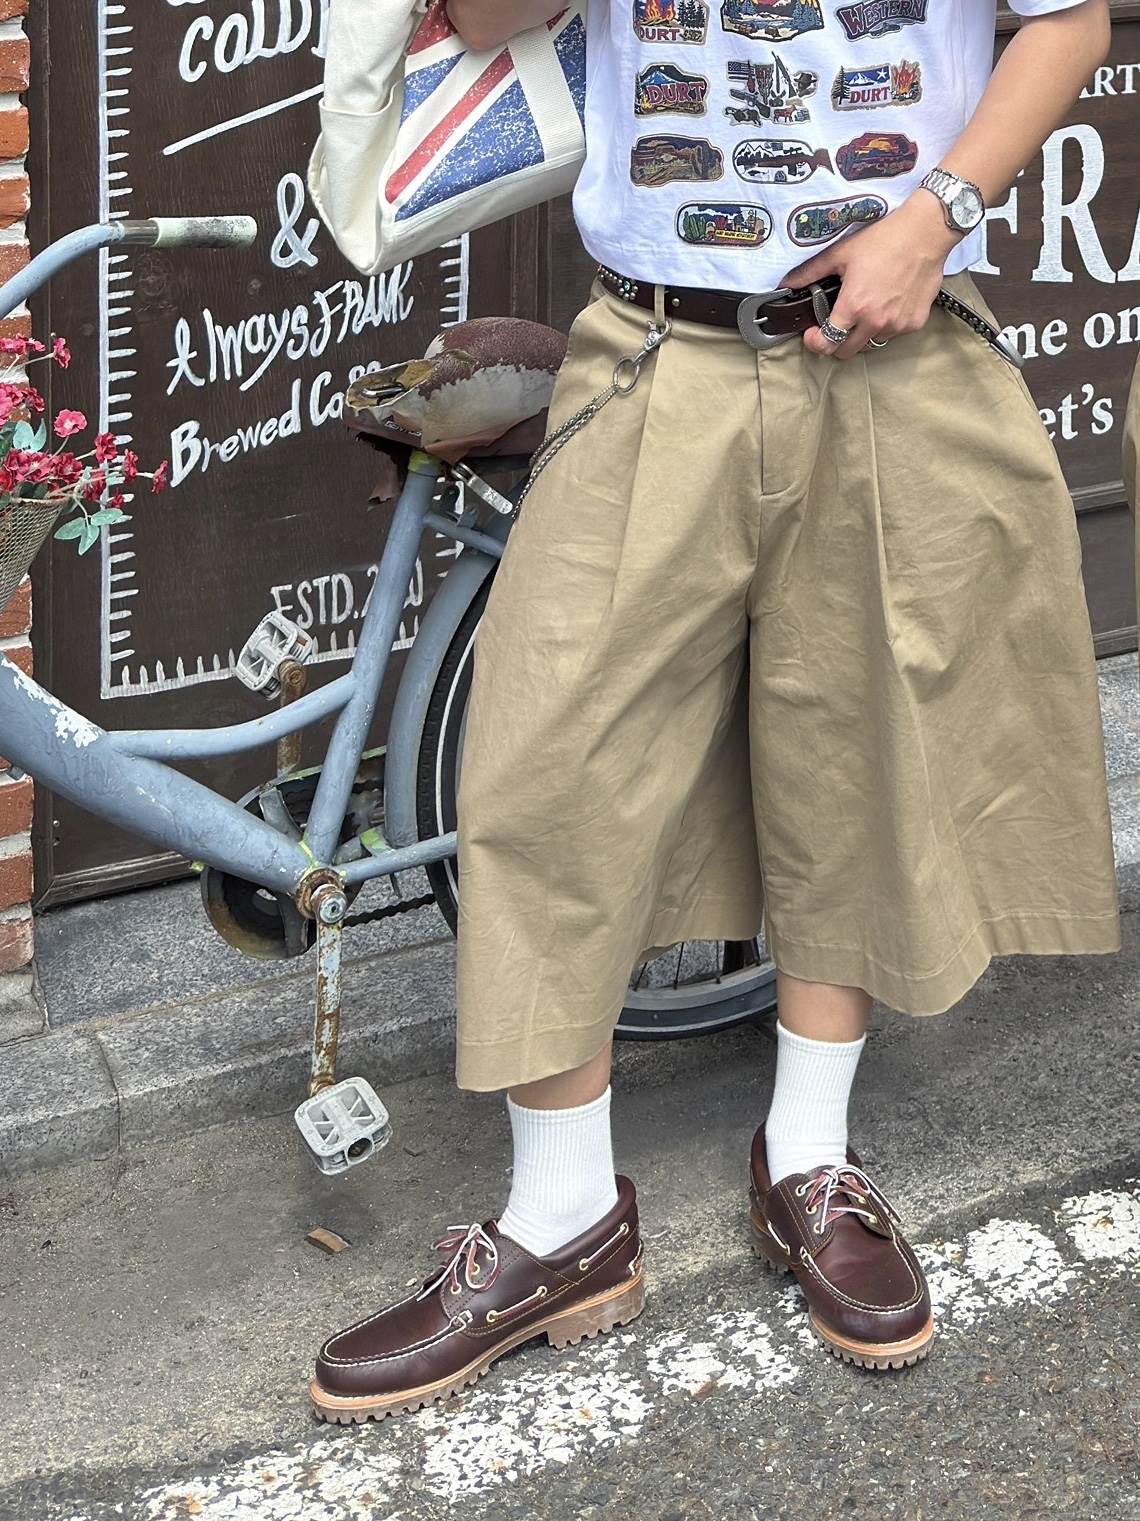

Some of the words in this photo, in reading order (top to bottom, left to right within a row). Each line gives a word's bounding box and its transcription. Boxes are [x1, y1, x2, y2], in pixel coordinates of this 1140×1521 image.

[646, 81, 705, 104] DURT
[848, 86, 890, 104] DURT
[166, 300, 310, 395] Always
[169, 378, 302, 487] Brewed
